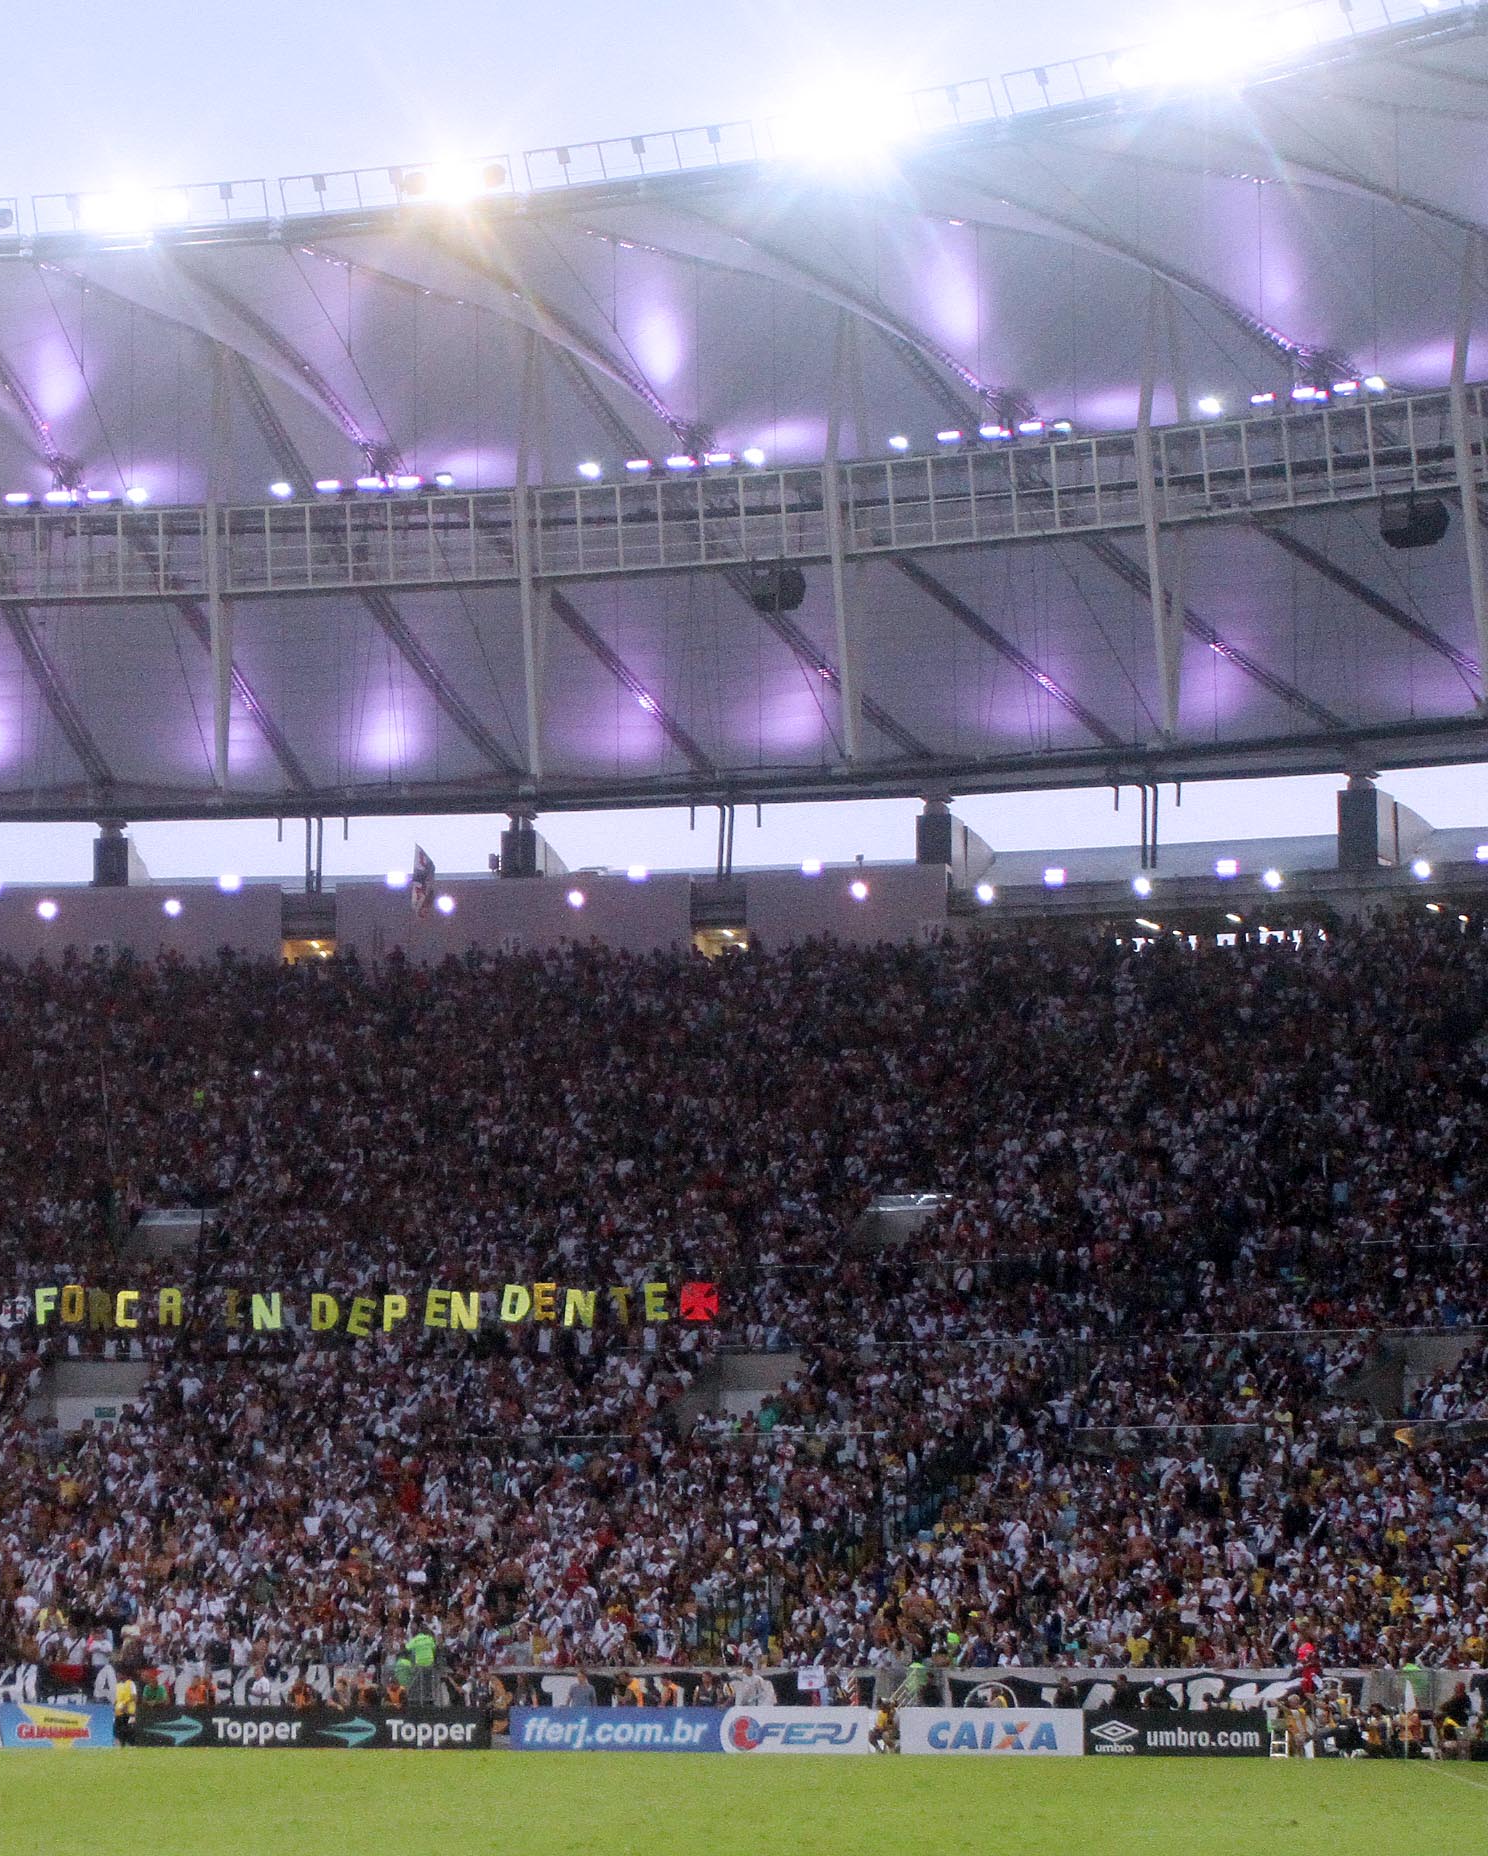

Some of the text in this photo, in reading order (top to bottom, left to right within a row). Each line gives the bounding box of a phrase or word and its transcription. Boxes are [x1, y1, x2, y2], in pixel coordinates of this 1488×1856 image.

[212, 1716, 303, 1746] Topper
[385, 1718, 477, 1747] Topper
[523, 1717, 709, 1750] fferj.com.br
[926, 1720, 1059, 1751] CAIXA
[1146, 1727, 1261, 1749] umbro.com
[1094, 1742, 1135, 1755] umbro
